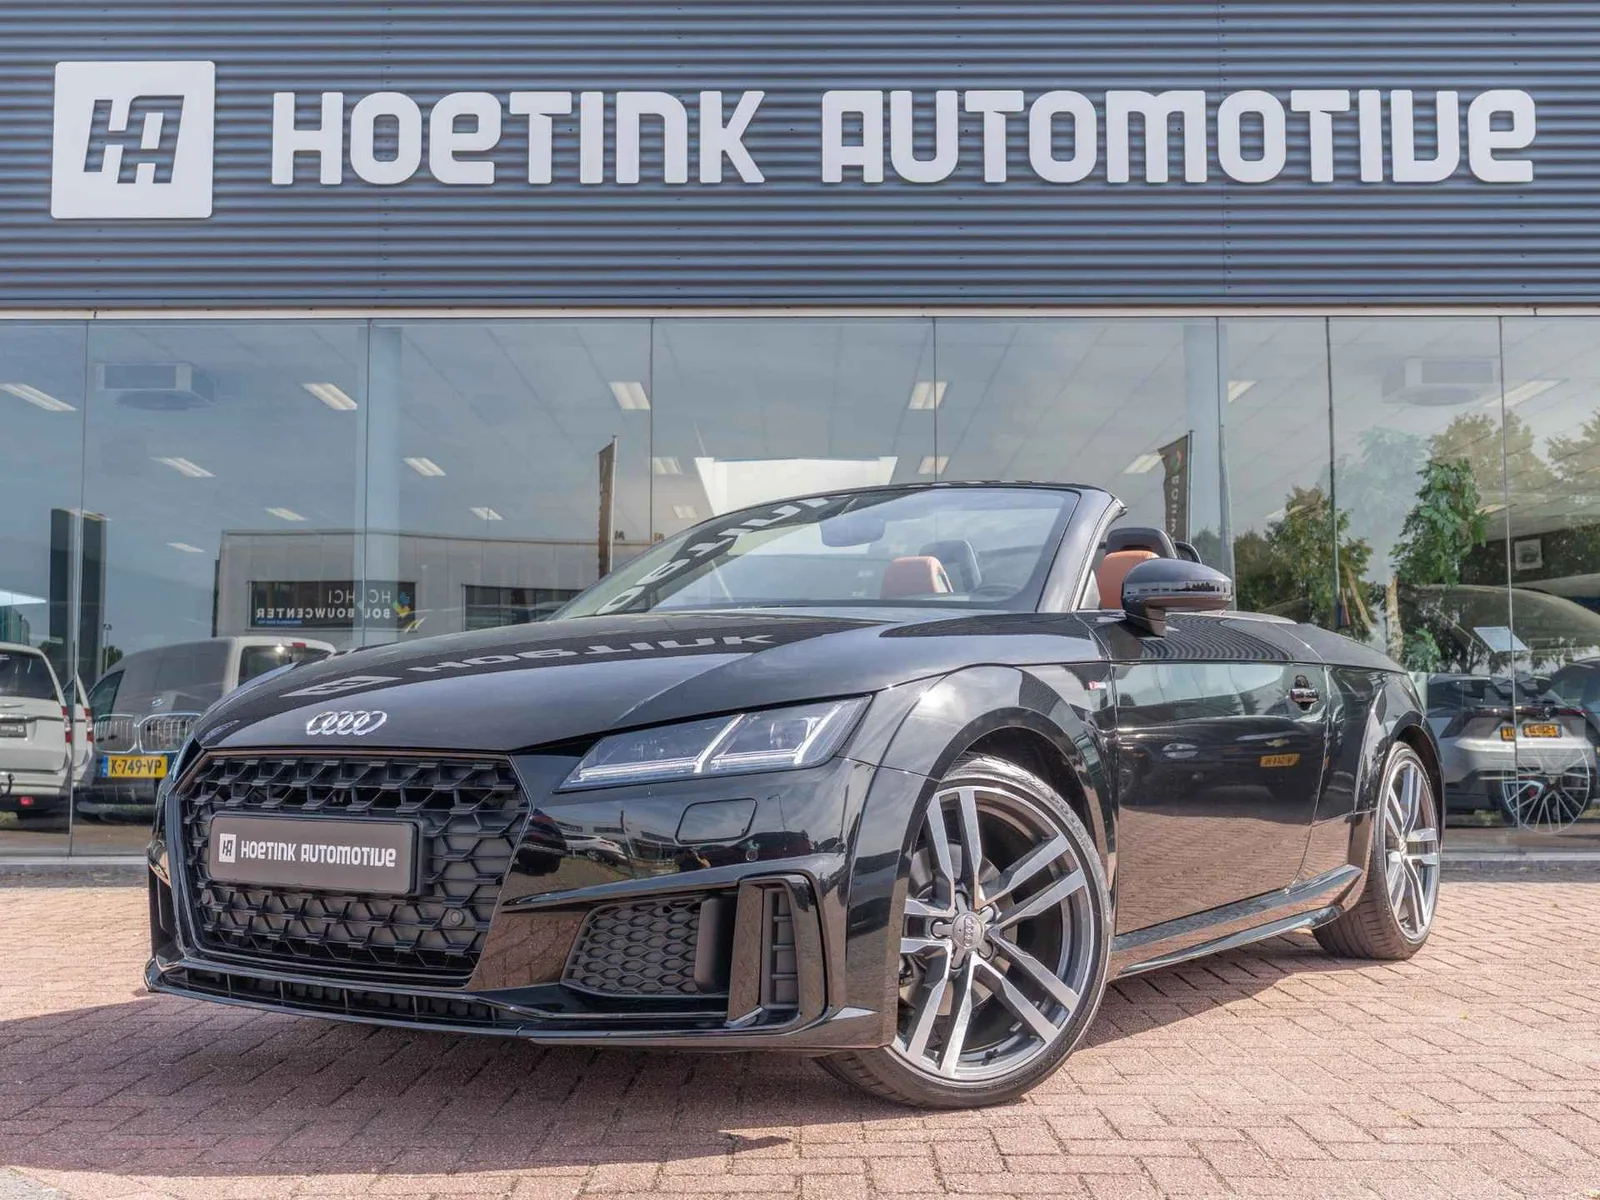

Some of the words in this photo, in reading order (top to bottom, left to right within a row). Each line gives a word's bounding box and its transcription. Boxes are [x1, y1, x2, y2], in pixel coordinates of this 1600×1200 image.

[821, 89, 1538, 184] AUTOMOTIVE
[111, 759, 162, 774] K-749-VP
[300, 844, 397, 867] AUTOMOTIVE
